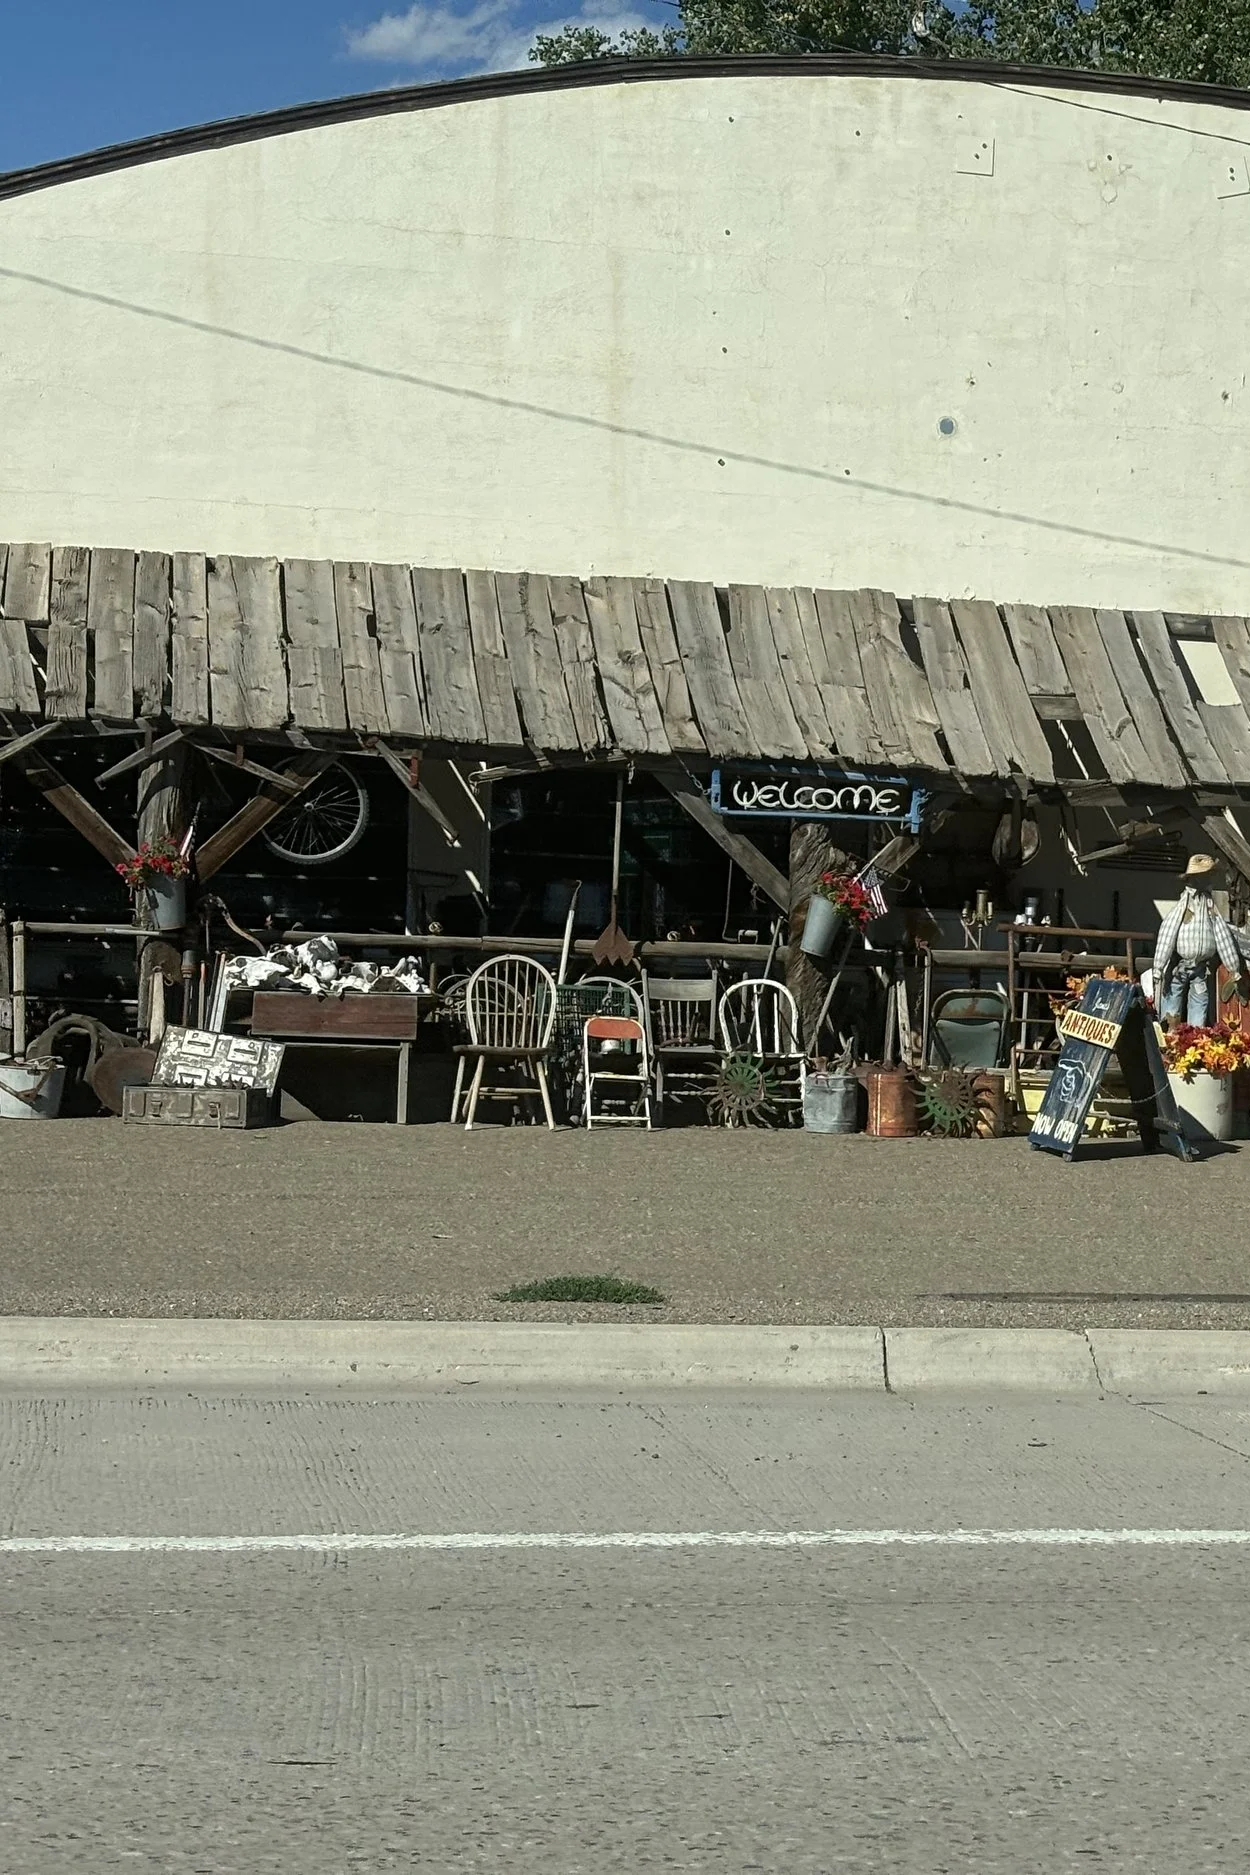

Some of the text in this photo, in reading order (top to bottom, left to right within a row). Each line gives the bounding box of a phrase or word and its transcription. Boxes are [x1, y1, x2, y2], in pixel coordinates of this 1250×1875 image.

[1062, 1014, 1116, 1044] ANTIQUES
[1032, 1112, 1078, 1144] NOW OPEN
